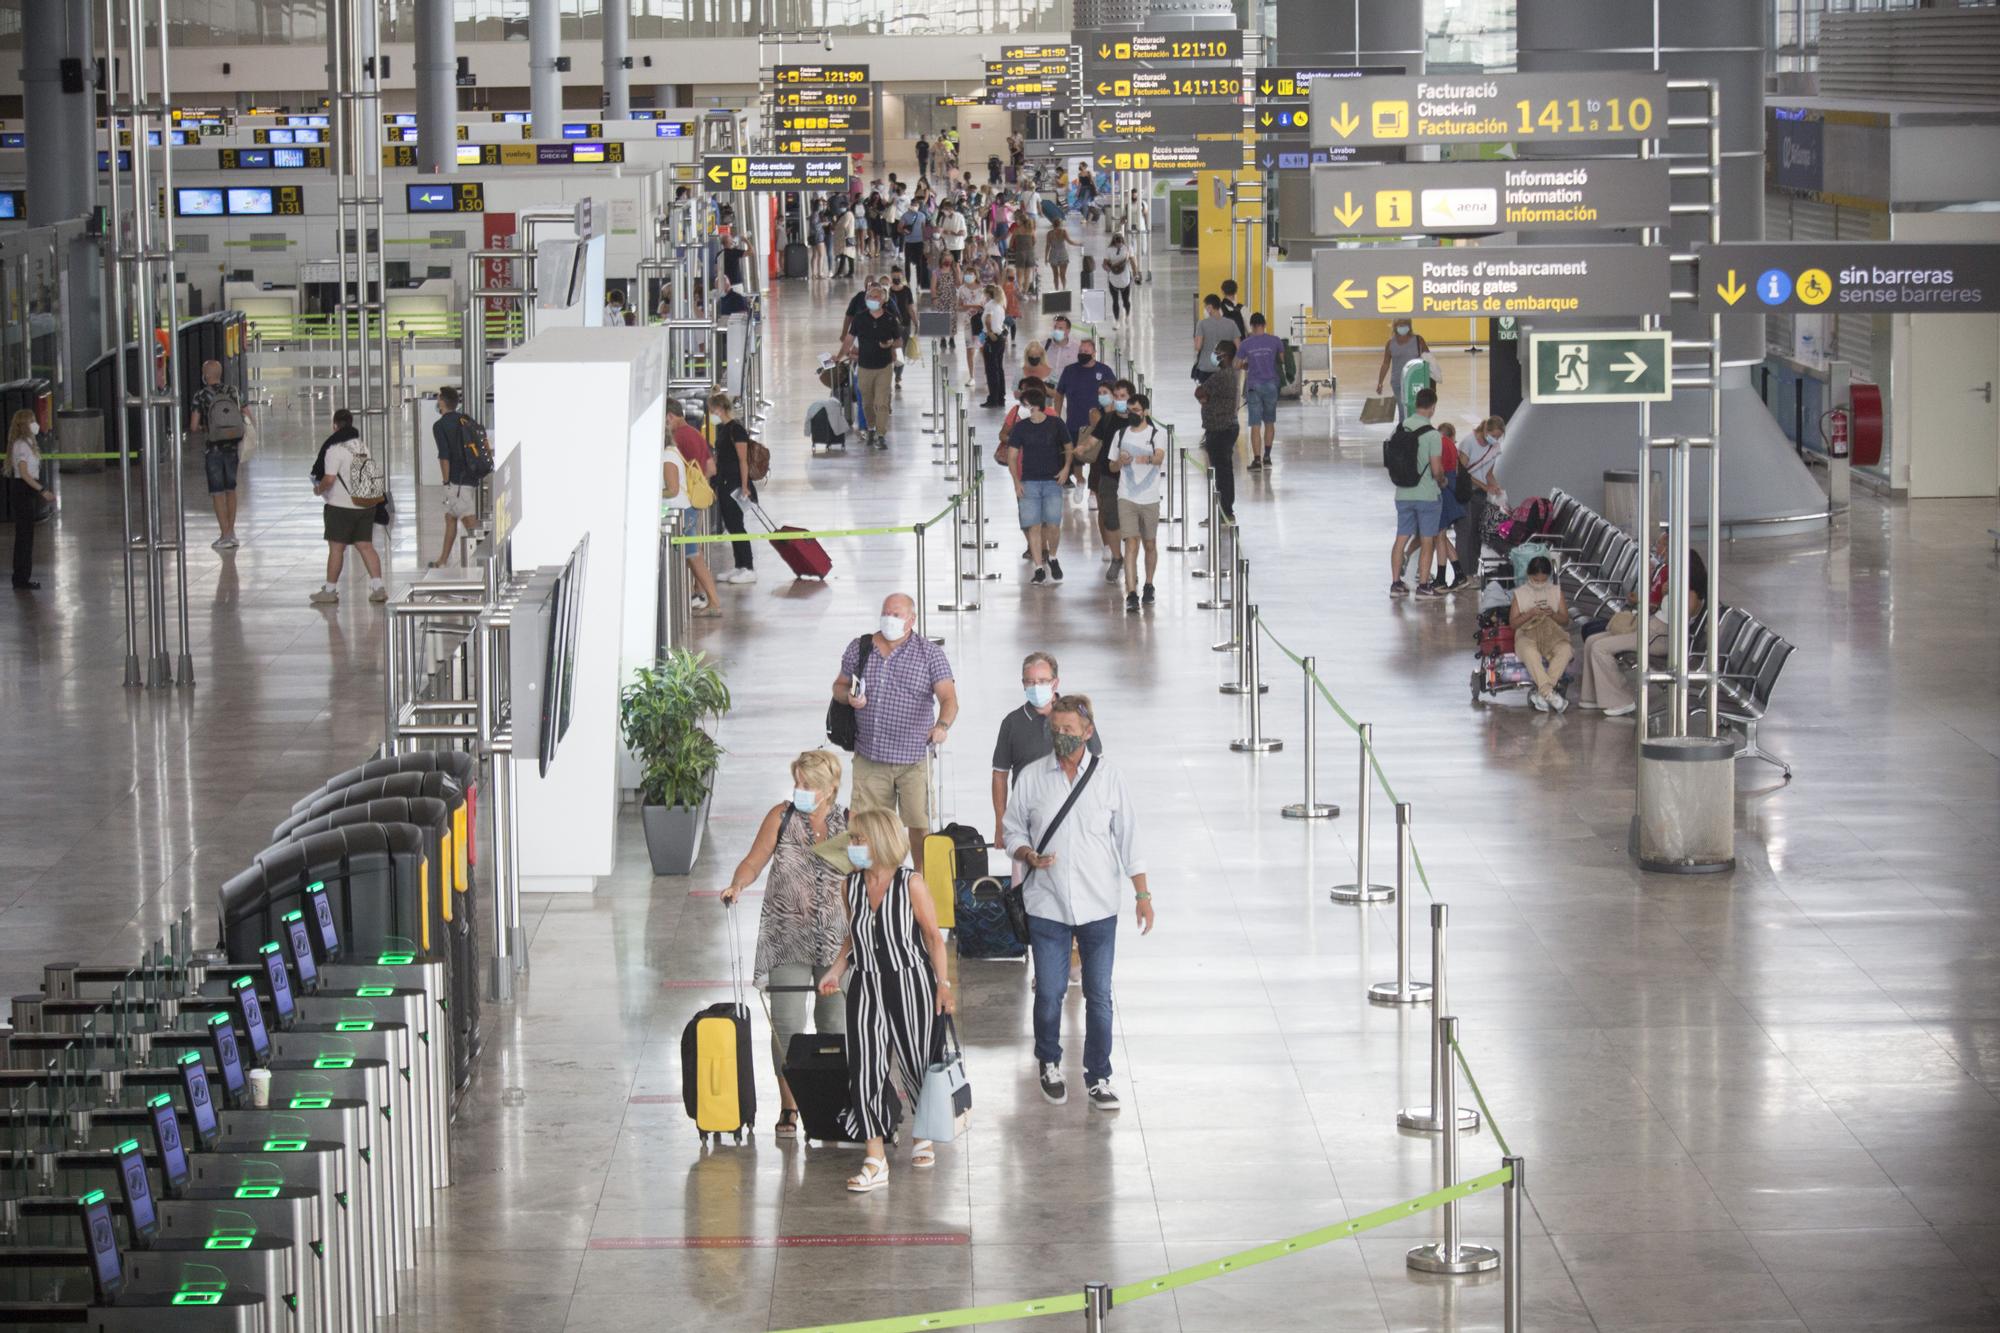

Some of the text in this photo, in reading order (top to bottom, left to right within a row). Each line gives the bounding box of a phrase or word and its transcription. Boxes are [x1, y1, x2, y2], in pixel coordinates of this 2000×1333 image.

[1171, 42, 1200, 57] 121
[1207, 41, 1227, 57] 10
[824, 71, 864, 82] 121 90
[1173, 80, 1202, 95] 141
[1209, 80, 1240, 95] 130
[1417, 82, 1498, 100] Facturació
[825, 94, 857, 105] 81 10
[1417, 101, 1477, 118] Check-in
[1515, 97, 1653, 134] 141 to a 10
[1417, 117, 1508, 136] Facturación
[608, 154, 622, 162] 90
[1505, 168, 1588, 186] Informació
[1505, 187, 1582, 204] Information
[278, 202, 301, 215] 131
[458, 199, 483, 212] 130
[1456, 201, 1488, 213] aena
[1505, 204, 1598, 223] Información
[1422, 260, 1588, 278] Portes d'embarcament
[1839, 266, 1954, 285] sin barreras
[1422, 279, 1518, 297] Boarding gates
[1839, 286, 1983, 303] sense barreres
[1422, 295, 1579, 314] Puertas de embarque
[1500, 331, 1518, 340] DEA
